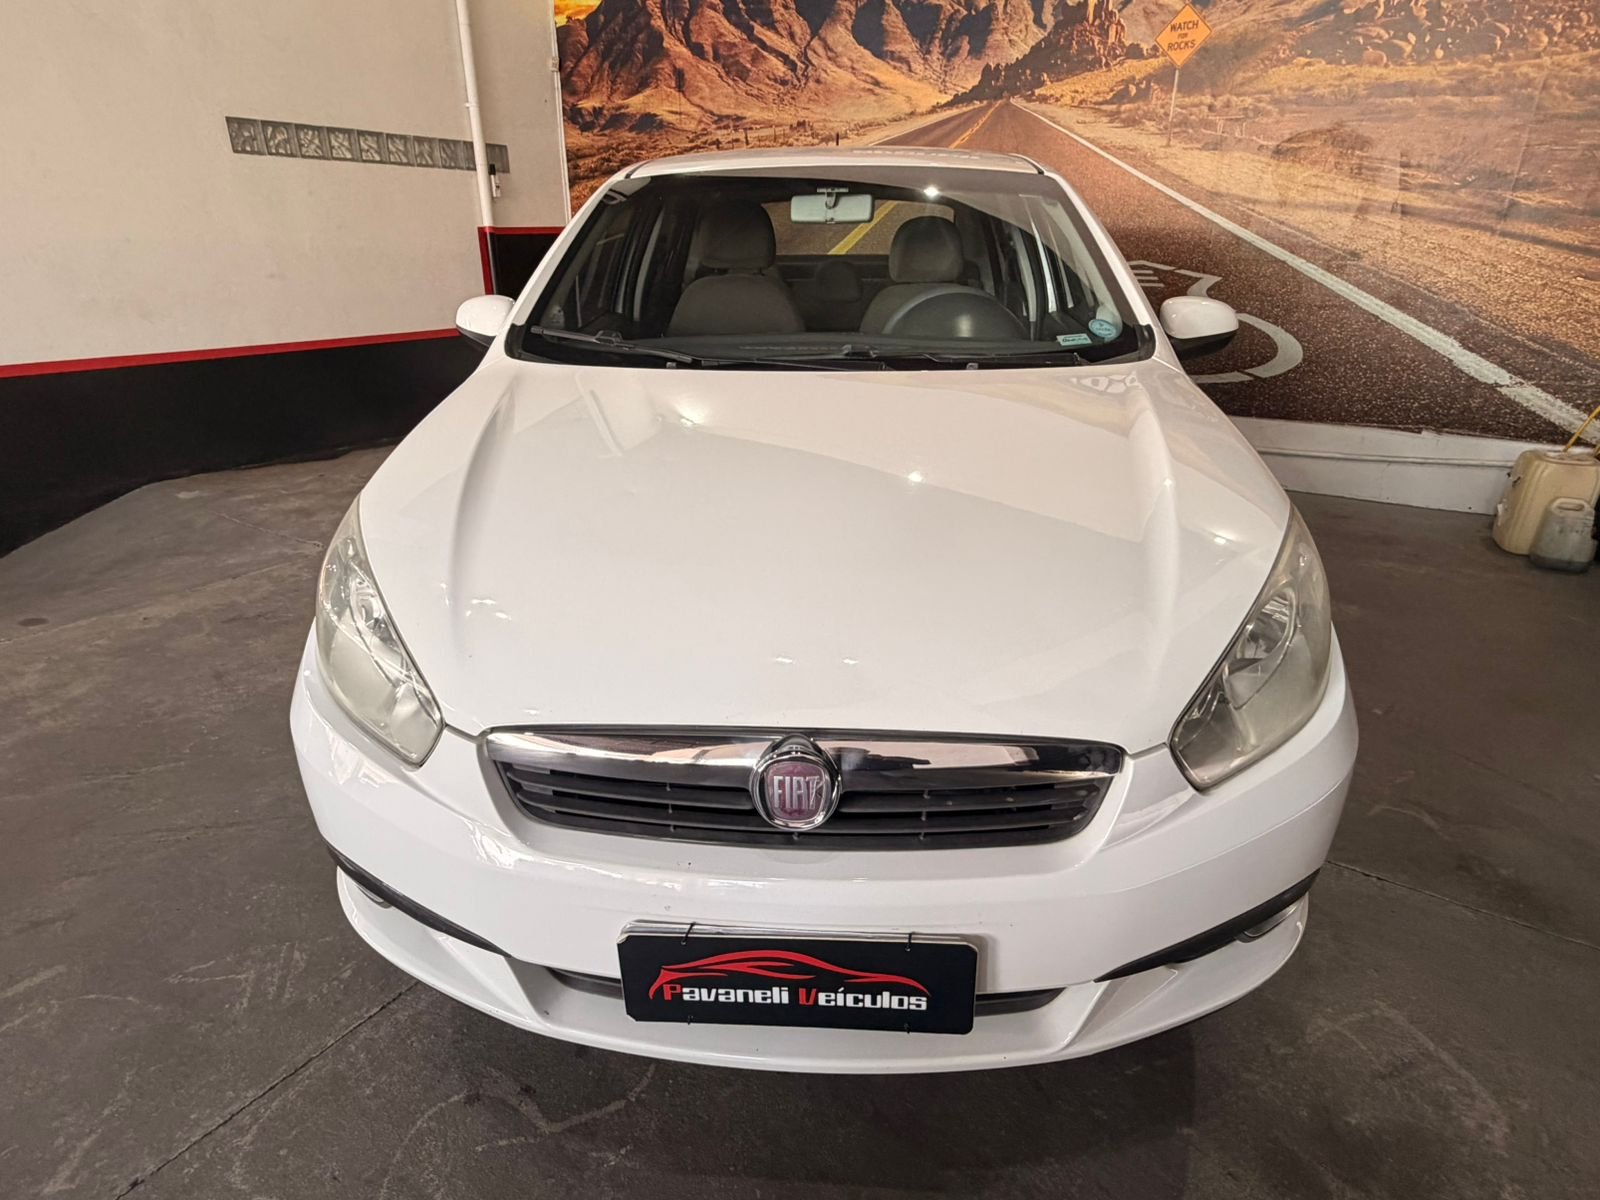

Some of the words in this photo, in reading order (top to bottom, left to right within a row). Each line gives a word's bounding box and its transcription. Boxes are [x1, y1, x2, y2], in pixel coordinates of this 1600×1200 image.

[1169, 20, 1199, 33] WATCH
[1167, 40, 1196, 51] ROCKS
[773, 775, 820, 810] FIAT
[663, 984, 789, 1004] Pavaneli
[799, 987, 927, 1010] Veículos
